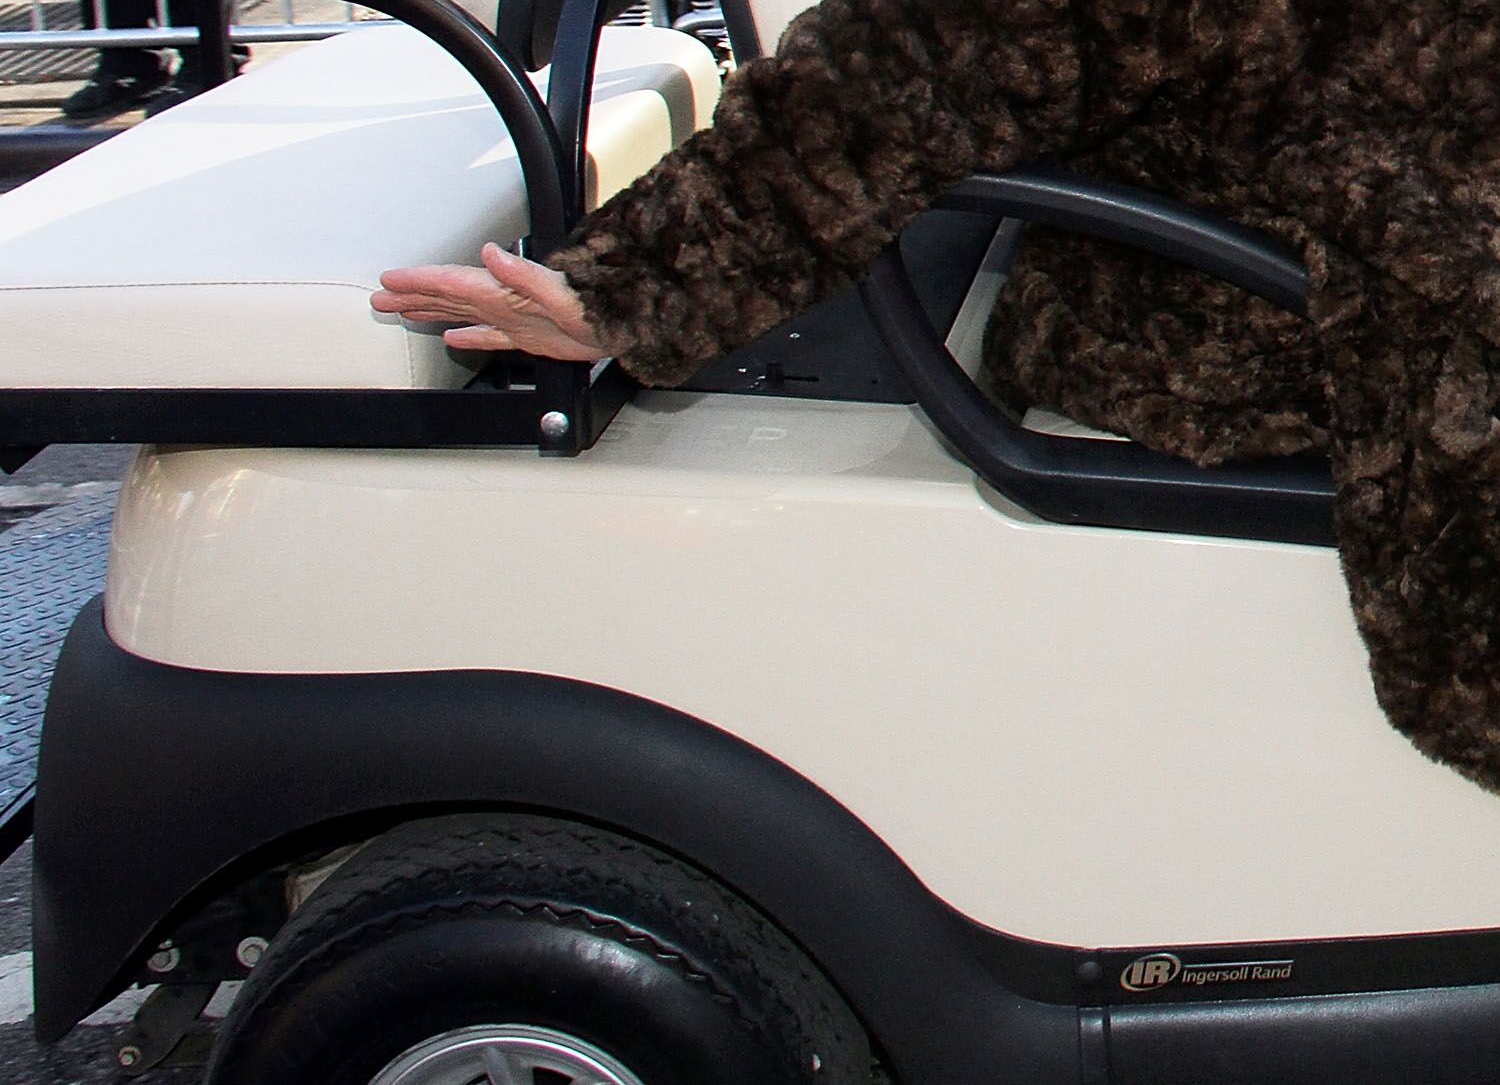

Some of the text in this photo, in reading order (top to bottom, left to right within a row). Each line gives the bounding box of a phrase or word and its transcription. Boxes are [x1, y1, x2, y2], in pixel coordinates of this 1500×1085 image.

[1130, 960, 1292, 985] IR Ingersoll Rand
